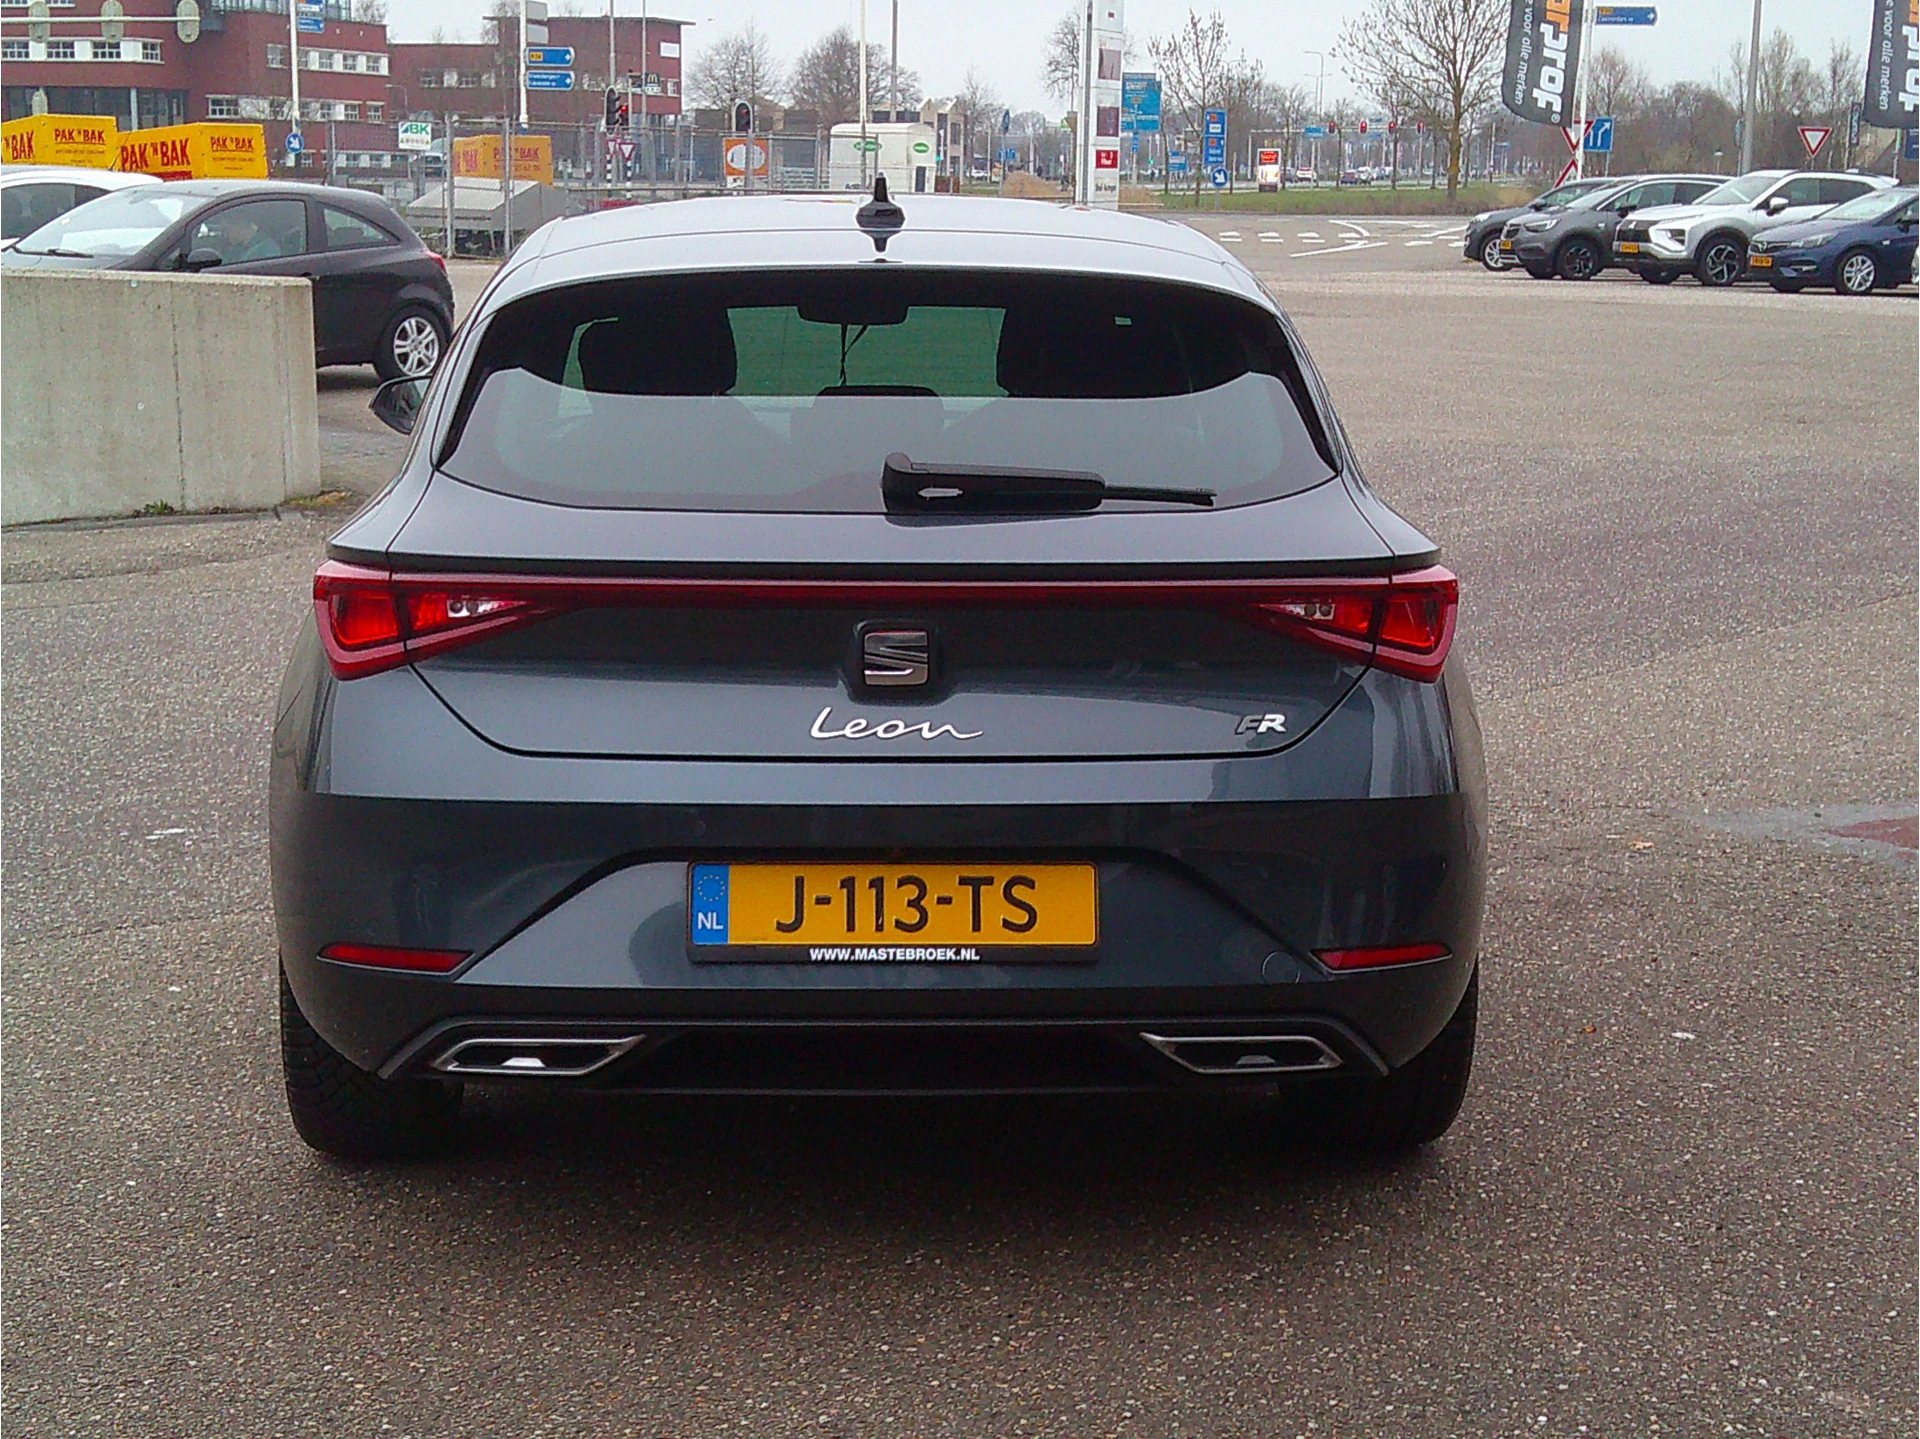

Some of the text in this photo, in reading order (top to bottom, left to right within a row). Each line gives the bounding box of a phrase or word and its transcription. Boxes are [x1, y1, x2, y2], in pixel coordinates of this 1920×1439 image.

[1523, 8, 1533, 36] voor
[1883, 10, 1894, 38] voor
[1520, 37, 1532, 60] alle
[1881, 40, 1894, 63] alle
[1514, 61, 1529, 105] merken
[1879, 66, 1892, 110] merken
[11, 130, 35, 160] BAK
[54, 128, 75, 142] PAK
[83, 129, 105, 143] BAK
[120, 143, 149, 171] PAK
[160, 138, 191, 167] BAK
[809, 707, 984, 740] Leon
[1235, 713, 1287, 735] FR
[775, 875, 1038, 933] J-113-TS
[697, 912, 723, 930] NL
[810, 948, 980, 961] WWW.MASTEBROEK.NL
